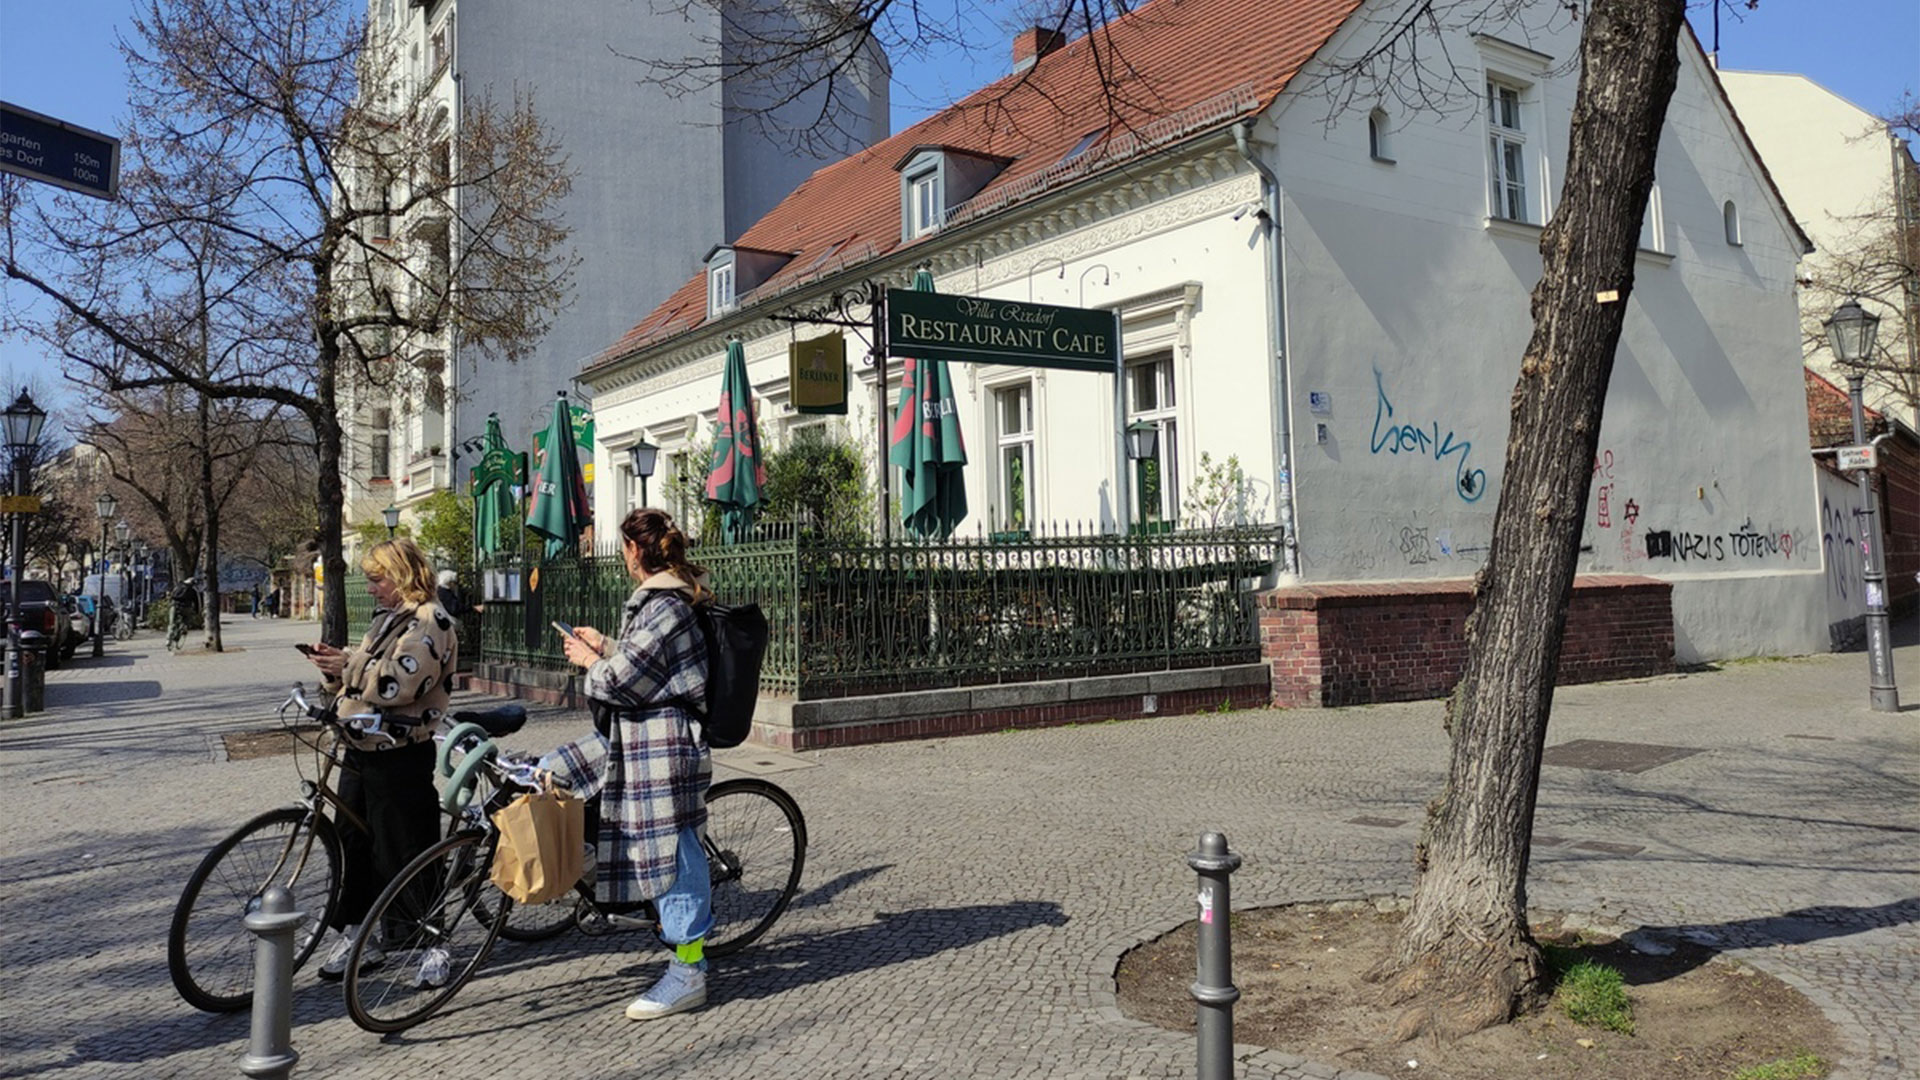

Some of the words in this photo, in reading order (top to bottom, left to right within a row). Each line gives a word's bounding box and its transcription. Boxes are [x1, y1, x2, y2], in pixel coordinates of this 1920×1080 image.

[0, 132, 41, 151] garten
[74, 152, 100, 168] 150m
[17, 149, 45, 168] Dorf
[72, 167, 98, 183] 100m
[956, 297, 994, 320] Villa
[1000, 303, 1059, 330] Rixdorf
[900, 313, 1046, 348] RESTAURANT
[799, 367, 840, 383] BERLINER
[1672, 531, 1724, 562] NAZIS
